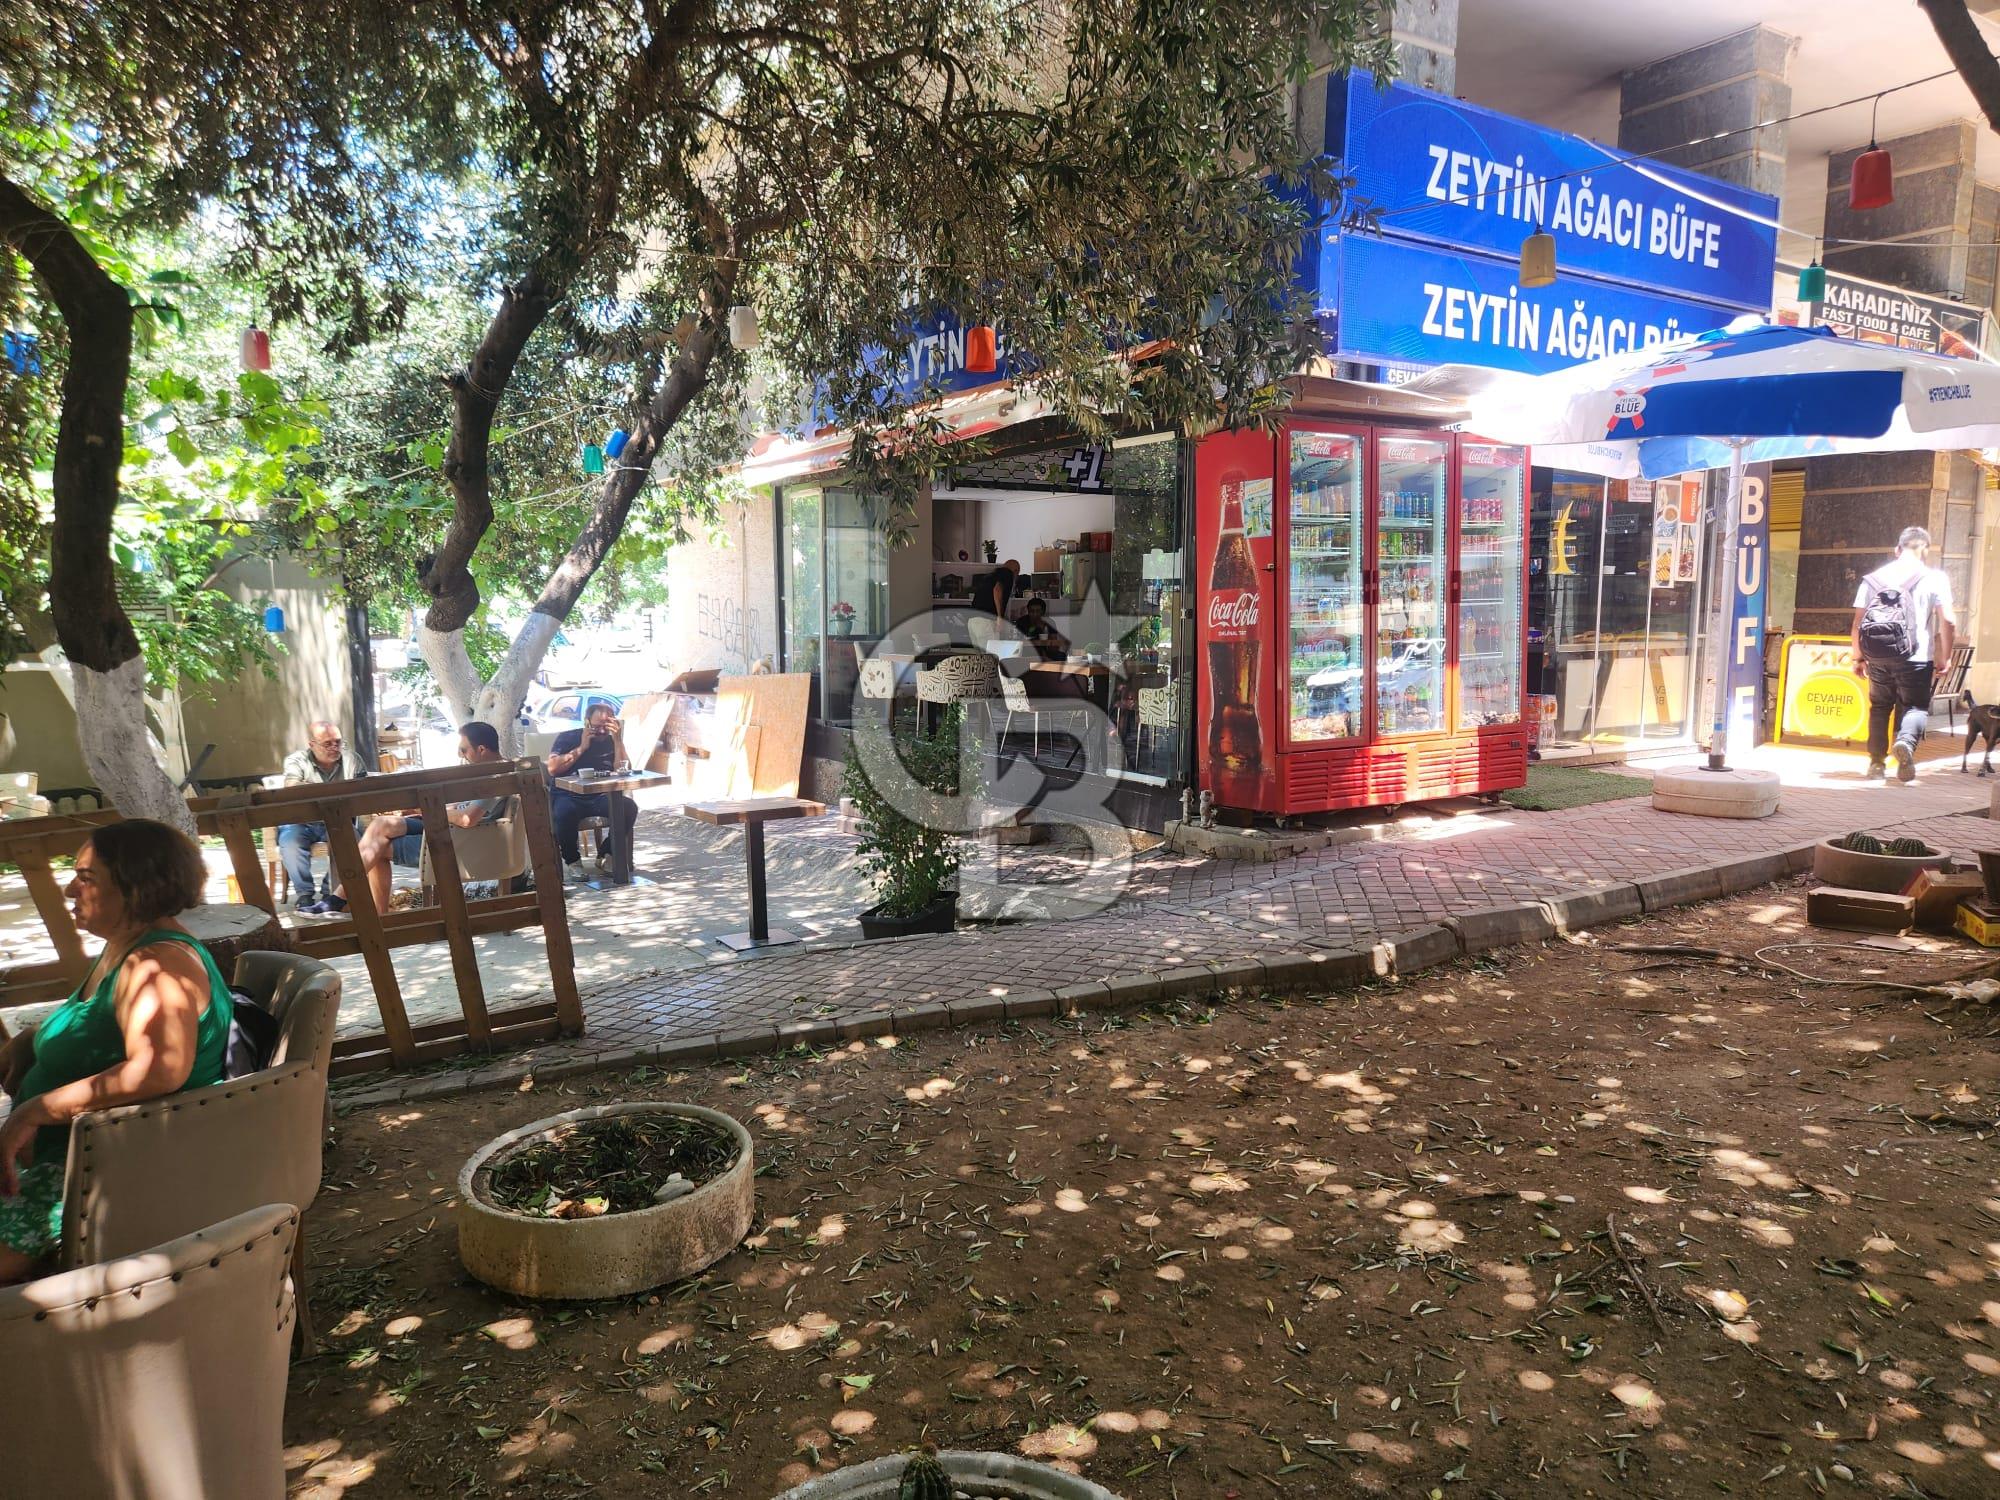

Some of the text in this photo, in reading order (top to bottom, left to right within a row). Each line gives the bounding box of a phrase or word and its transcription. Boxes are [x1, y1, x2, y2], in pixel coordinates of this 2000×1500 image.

[1426, 145, 1721, 268] ZEYTİN AĞACI BÜFE
[1422, 282, 1540, 352] ZEYTİN
[1822, 307, 1931, 341] FAST FOOD & CAFE
[1615, 402, 1641, 414] BLUE
[1208, 593, 1259, 628] Coca-Cola
